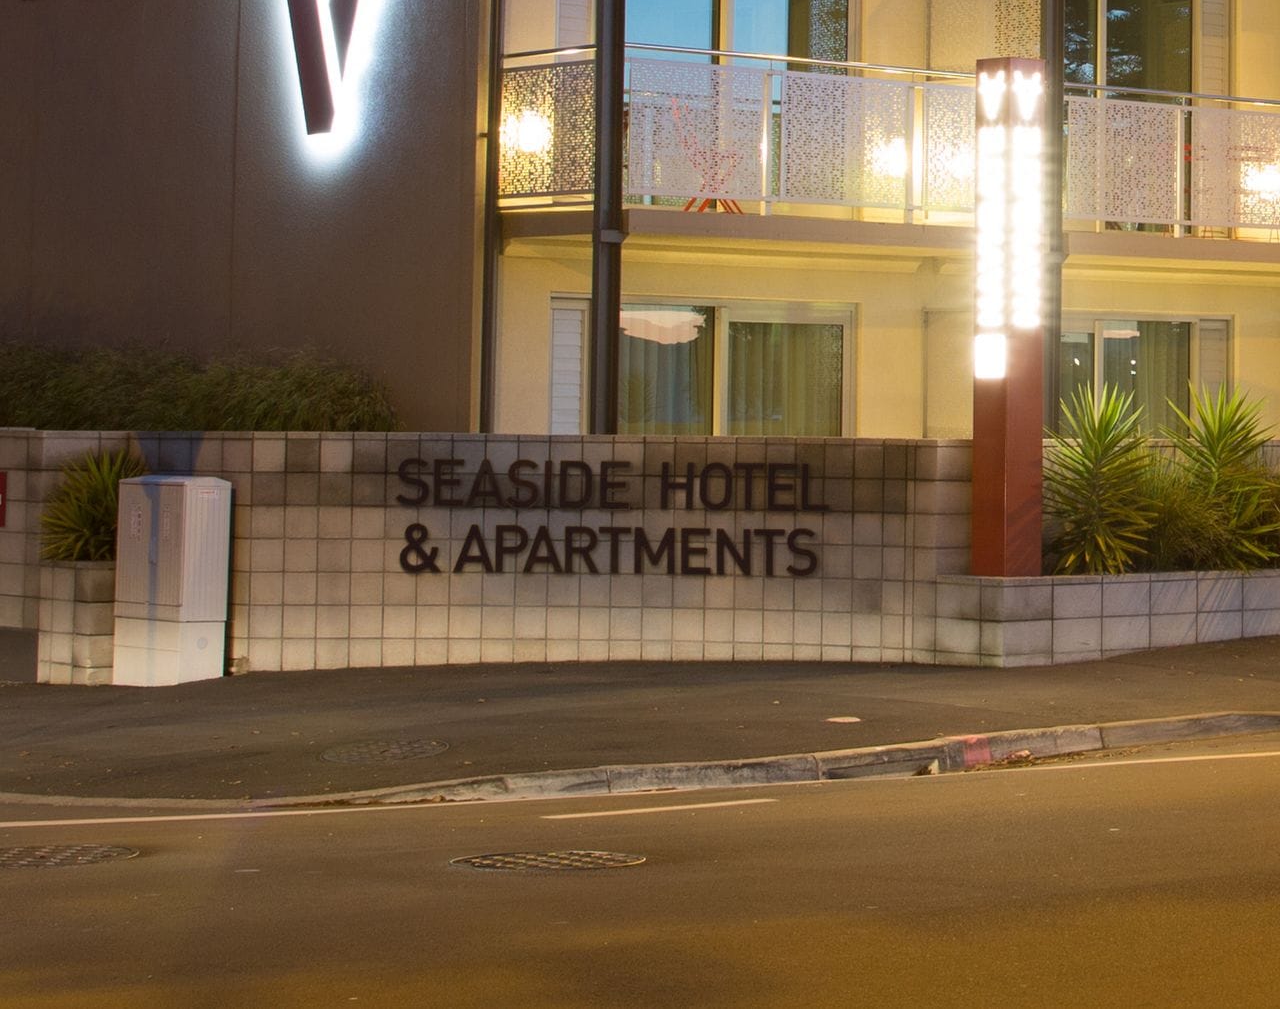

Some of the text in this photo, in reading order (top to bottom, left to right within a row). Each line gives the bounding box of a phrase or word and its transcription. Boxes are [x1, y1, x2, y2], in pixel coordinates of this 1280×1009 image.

[396, 458, 829, 512] SEASIDE HOTEL
[399, 523, 818, 577] & APARTMENTS
